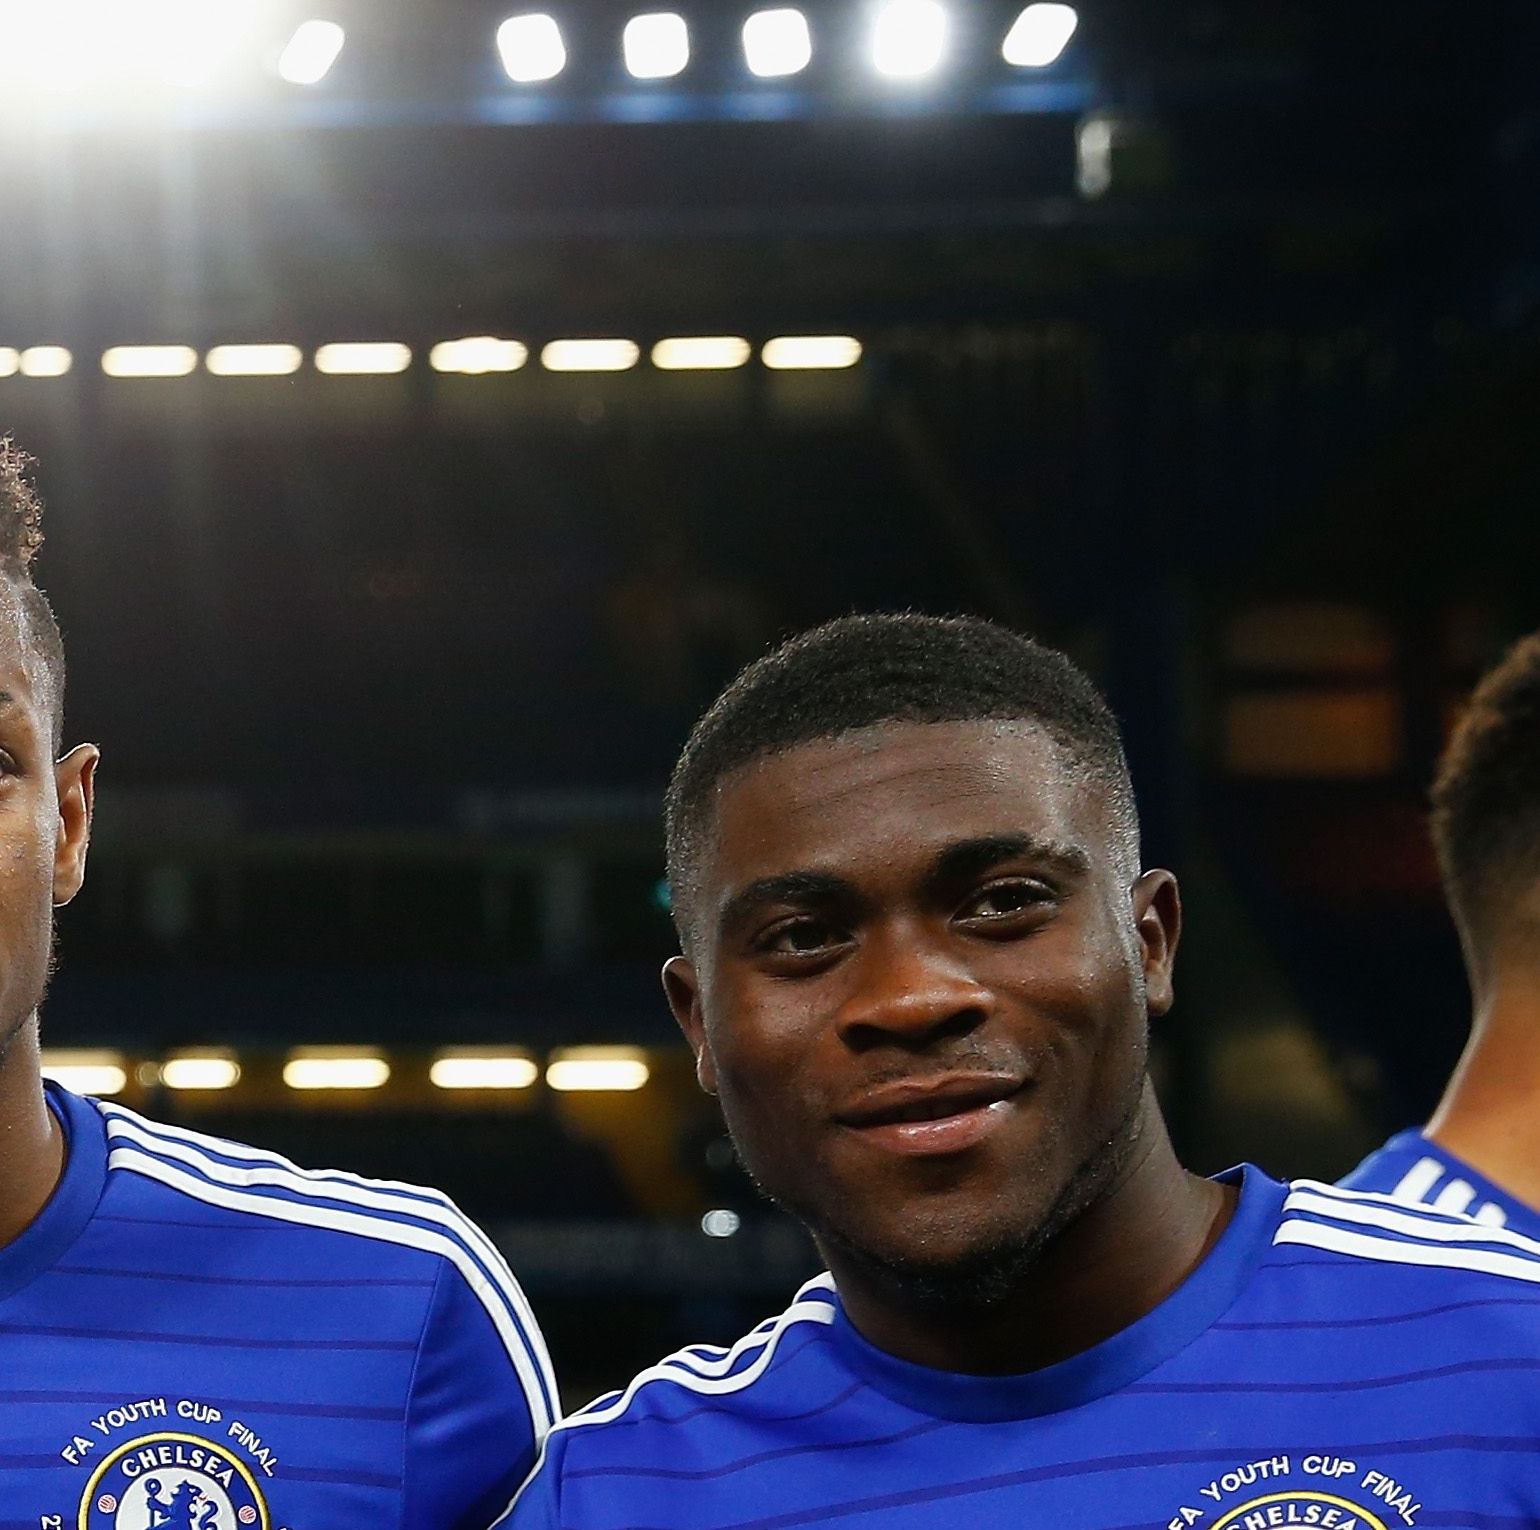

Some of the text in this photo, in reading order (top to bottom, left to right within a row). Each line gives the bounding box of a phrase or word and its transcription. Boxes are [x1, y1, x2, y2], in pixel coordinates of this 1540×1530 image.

[61, 1397, 279, 1477] FA YOUTH CUP FINAL
[121, 1445, 236, 1488] CHELSEA
[1199, 1454, 1291, 1502] YOUTH
[1301, 1454, 1356, 1478] CUP
[1360, 1470, 1423, 1526] FINAL
